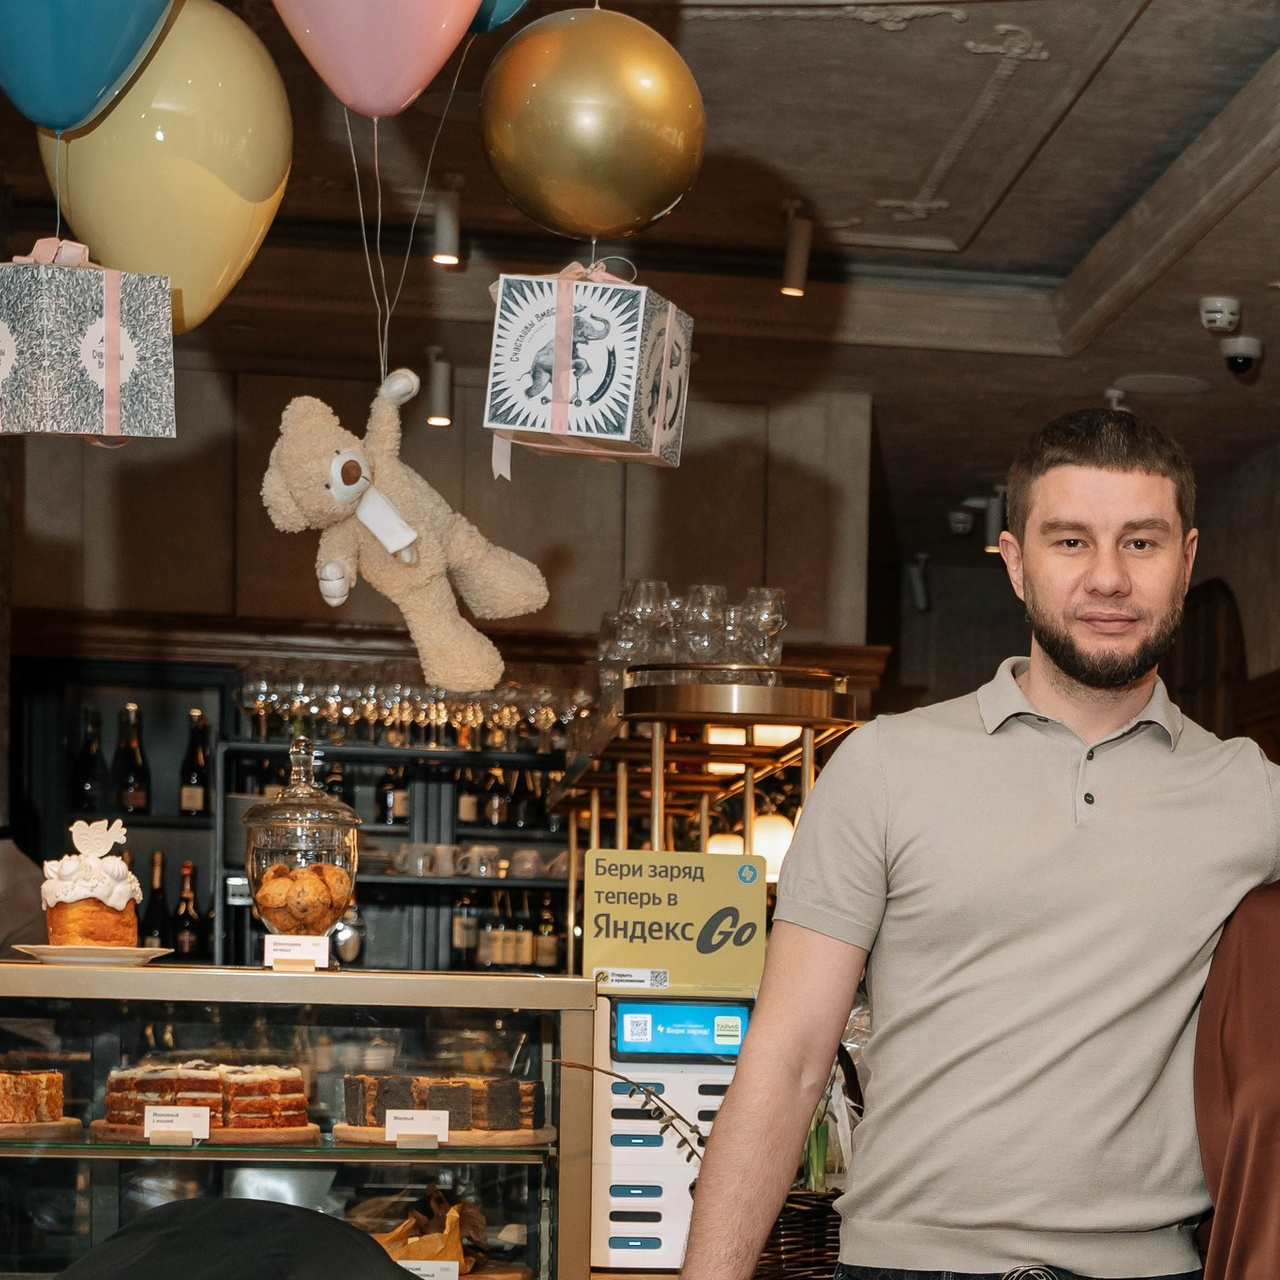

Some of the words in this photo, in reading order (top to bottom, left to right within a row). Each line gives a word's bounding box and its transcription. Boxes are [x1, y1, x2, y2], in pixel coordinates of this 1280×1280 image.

[594, 858, 643, 882] Бери
[648, 864, 705, 882] заряд
[594, 890, 662, 908] теперь
[667, 893, 678, 906] в
[593, 913, 694, 943] Яндекс
[696, 906, 757, 954] Go
